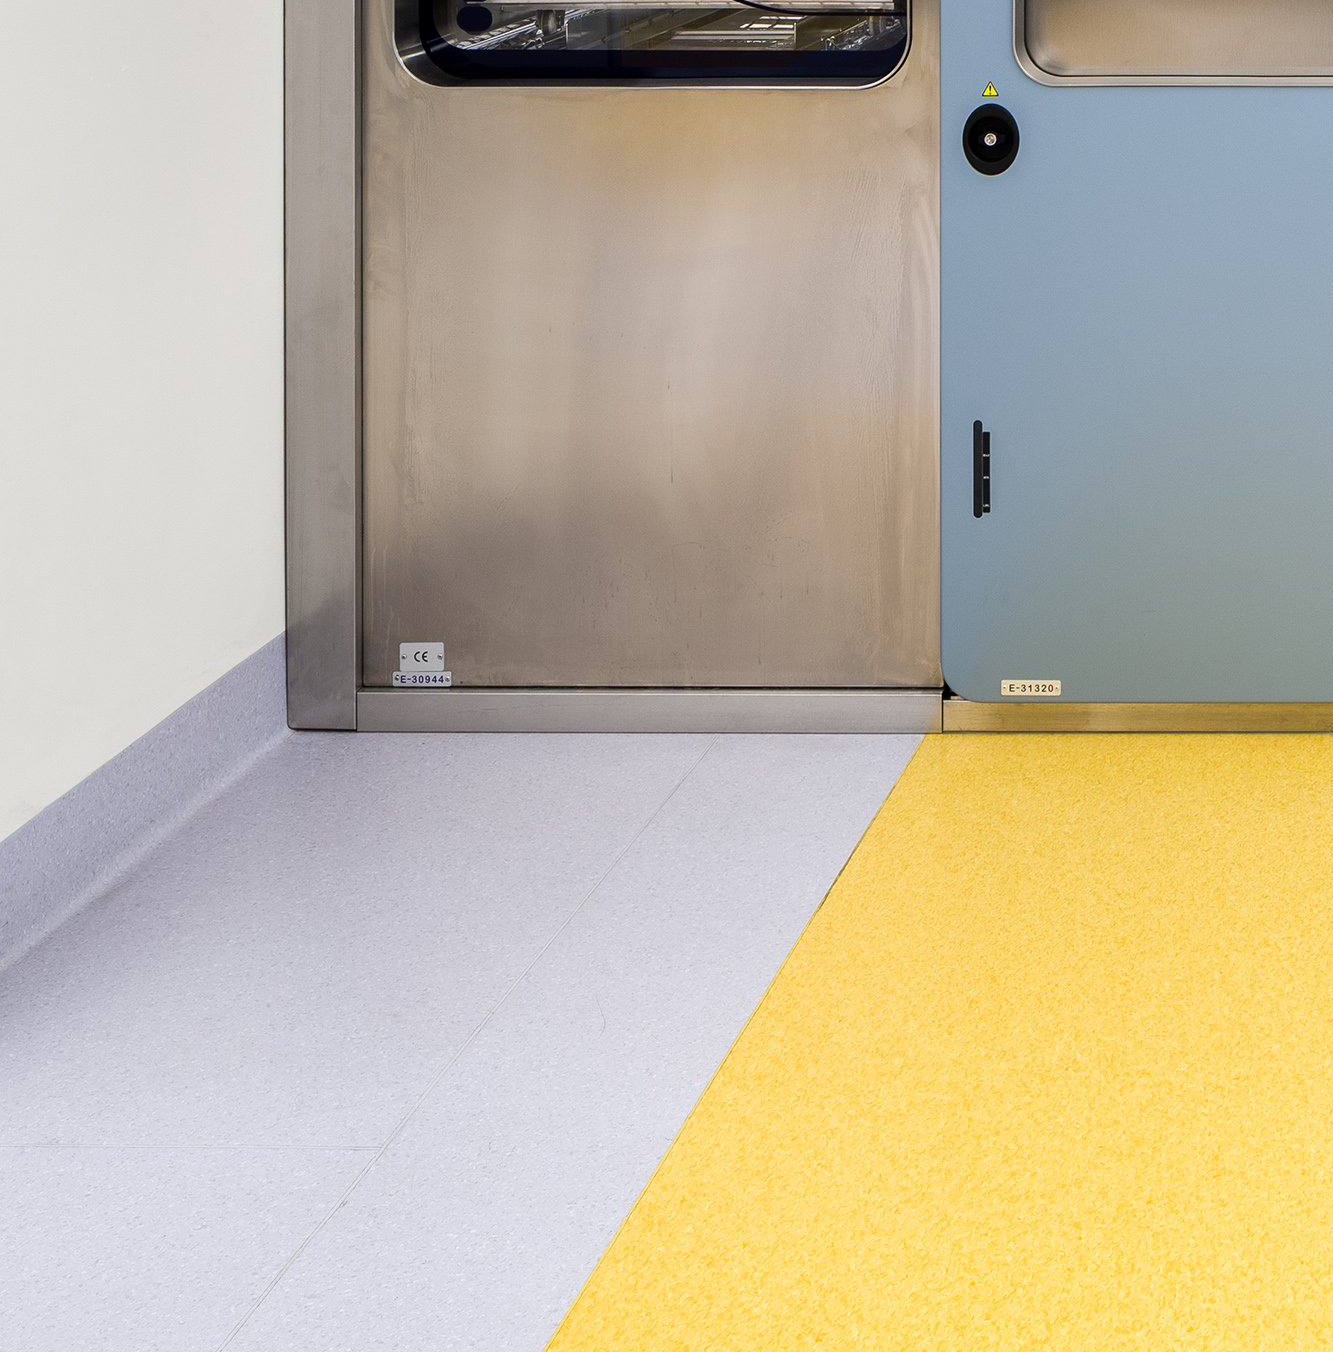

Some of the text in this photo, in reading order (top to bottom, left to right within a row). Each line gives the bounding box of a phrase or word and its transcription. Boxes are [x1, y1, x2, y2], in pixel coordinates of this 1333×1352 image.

[414, 651, 428, 662] CE
[400, 675, 444, 683] E-30944
[1009, 684, 1054, 692] E-31320
